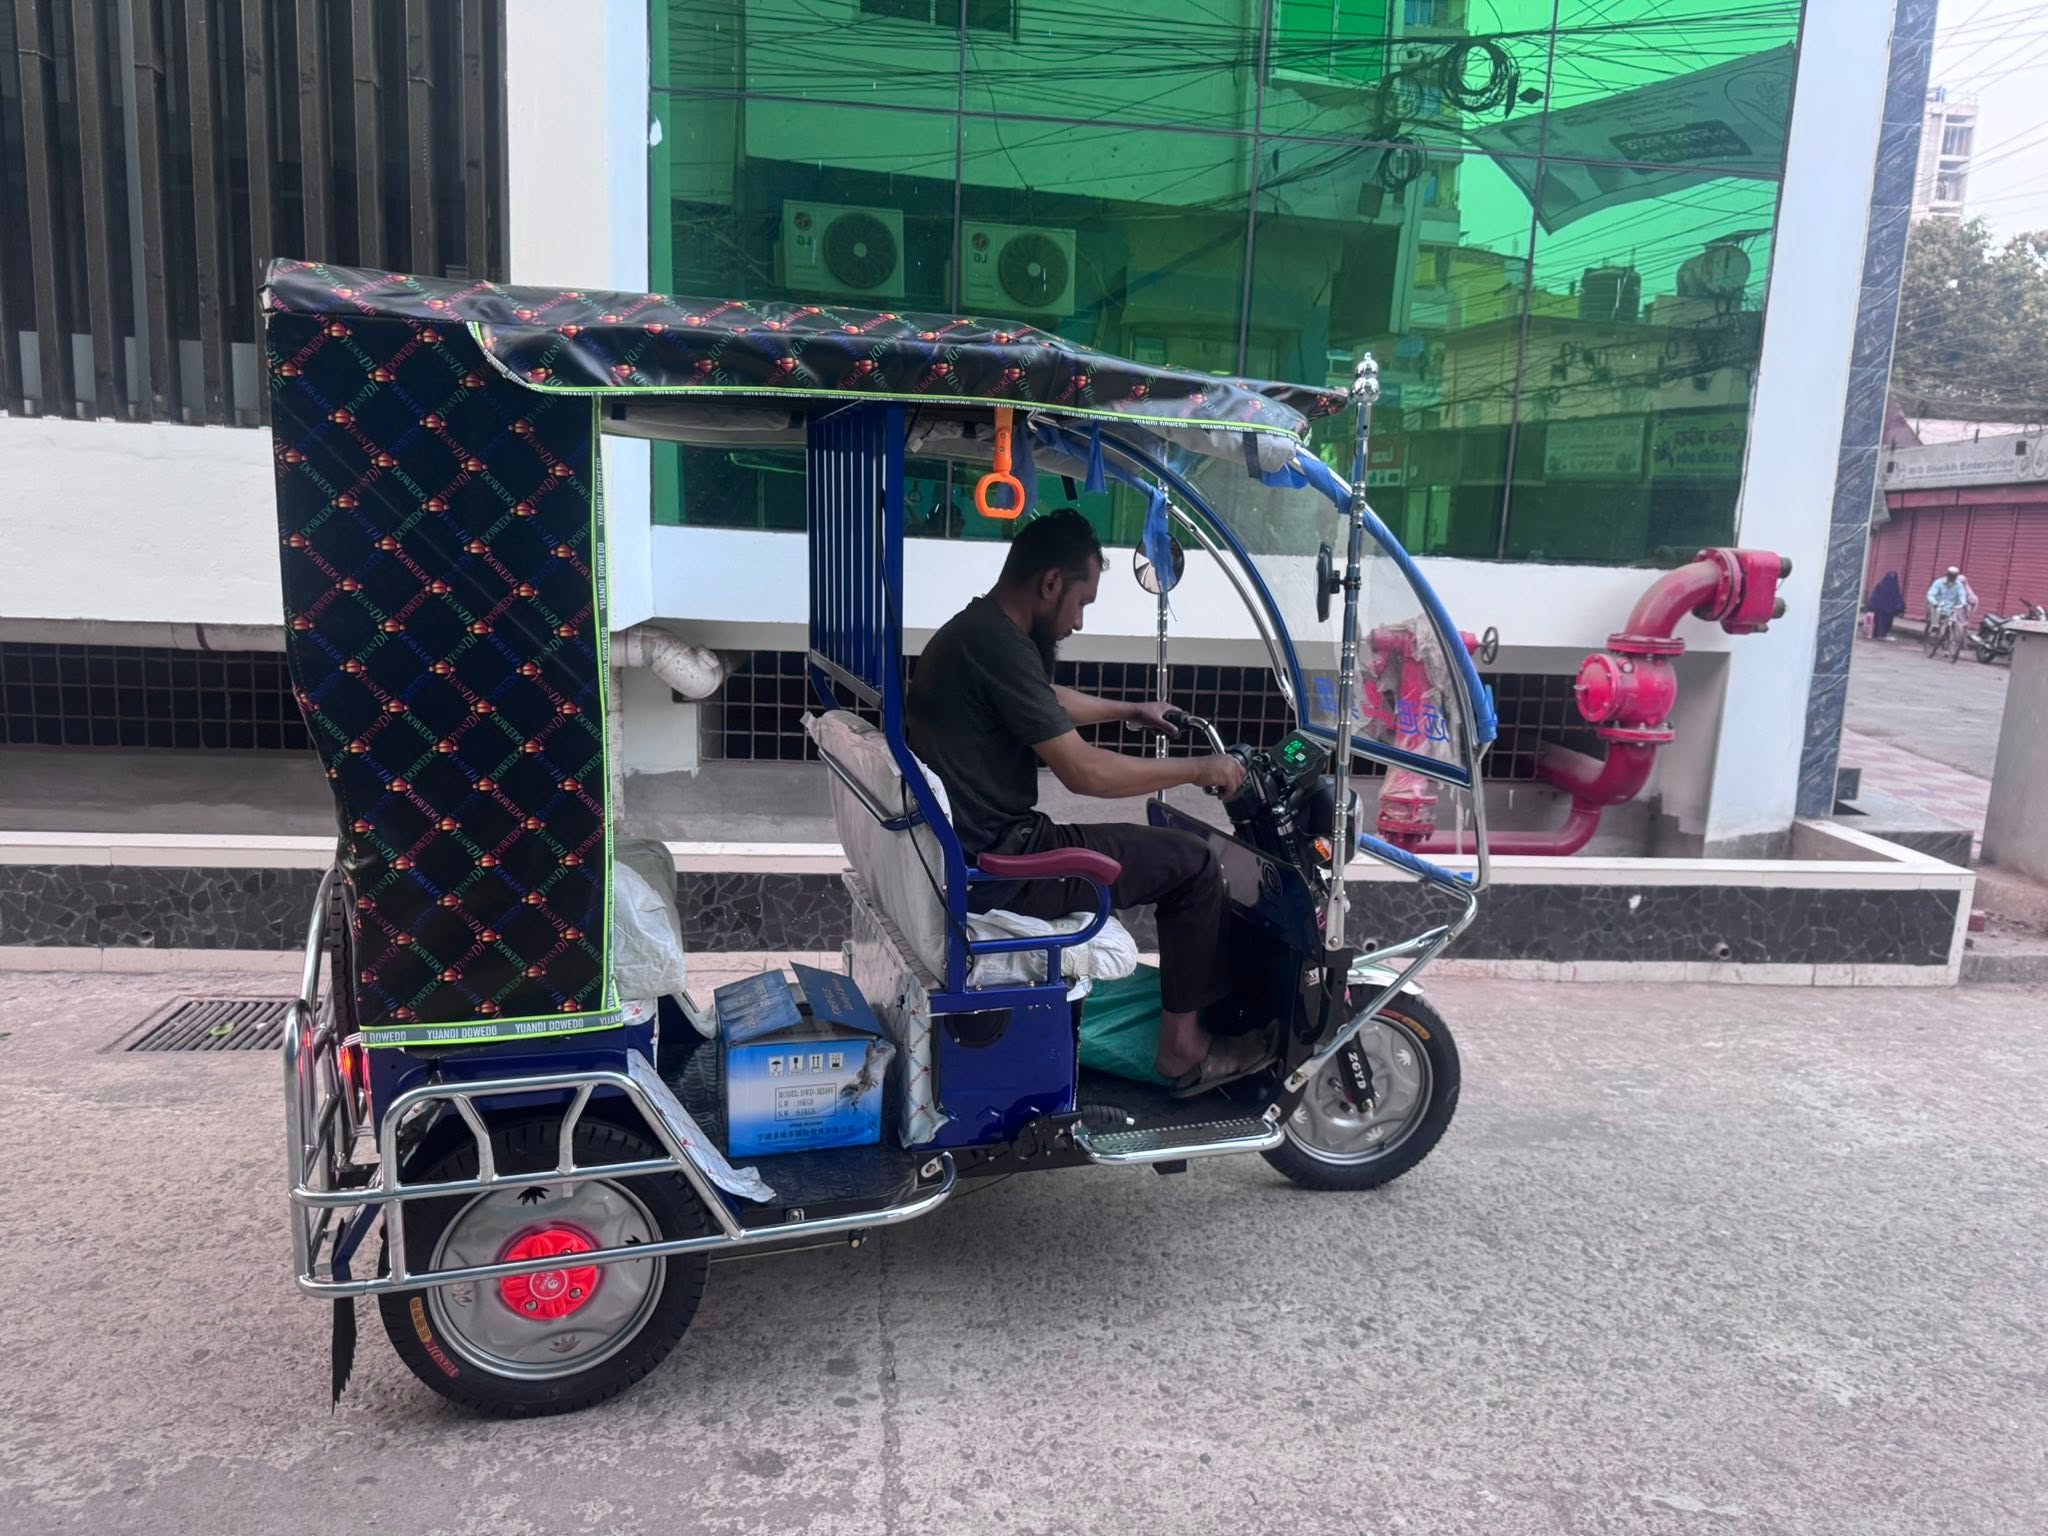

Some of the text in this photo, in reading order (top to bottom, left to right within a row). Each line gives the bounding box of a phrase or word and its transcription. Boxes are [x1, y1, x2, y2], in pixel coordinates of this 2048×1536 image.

[299, 462, 338, 498] DOWEDO
[1926, 462, 1958, 474] Sheikh
[1960, 459, 2015, 473] Enterprise
[392, 466, 428, 502] DOWEDO
[481, 471, 517, 507] DOWEDO
[300, 502, 337, 538] DOWEDO
[392, 507, 428, 541] DOWEDO
[481, 510, 515, 544] DOWEDO
[304, 546, 342, 581] DOWEDO
[394, 548, 432, 584] DOWEDO
[483, 552, 521, 588] DOWEDO
[597, 542, 606, 577] DOWEDO
[351, 590, 387, 623] YUANDI
[442, 593, 476, 626] YUANDI
[528, 596, 562, 629] YUANDI
[353, 671, 391, 705] YUANDI
[312, 711, 350, 744] DOWEDO
[401, 711, 439, 744] DOWEDO
[489, 711, 525, 745] DOWEDO
[403, 749, 438, 781] DOWEDO
[490, 748, 523, 780] DOWEDO
[403, 790, 442, 823] DOWEDO
[491, 788, 527, 821] DOWEDO
[405, 827, 440, 861] DOWEDO
[449, 828, 484, 859] YUANDI
[534, 827, 568, 858] YUANDI
[453, 864, 486, 897] YUANDI
[537, 865, 570, 896] YUANDI
[409, 941, 446, 975] DOWEDO
[495, 939, 529, 973] DOWEDO
[406, 976, 442, 1010] DOWEDO
[492, 974, 526, 1006] DOWEDO
[370, 1031, 407, 1043] DOWEDO
[427, 1025, 498, 1041] YUANDI DOWEDO
[515, 1018, 584, 1034] YUANDI DOWEDO
